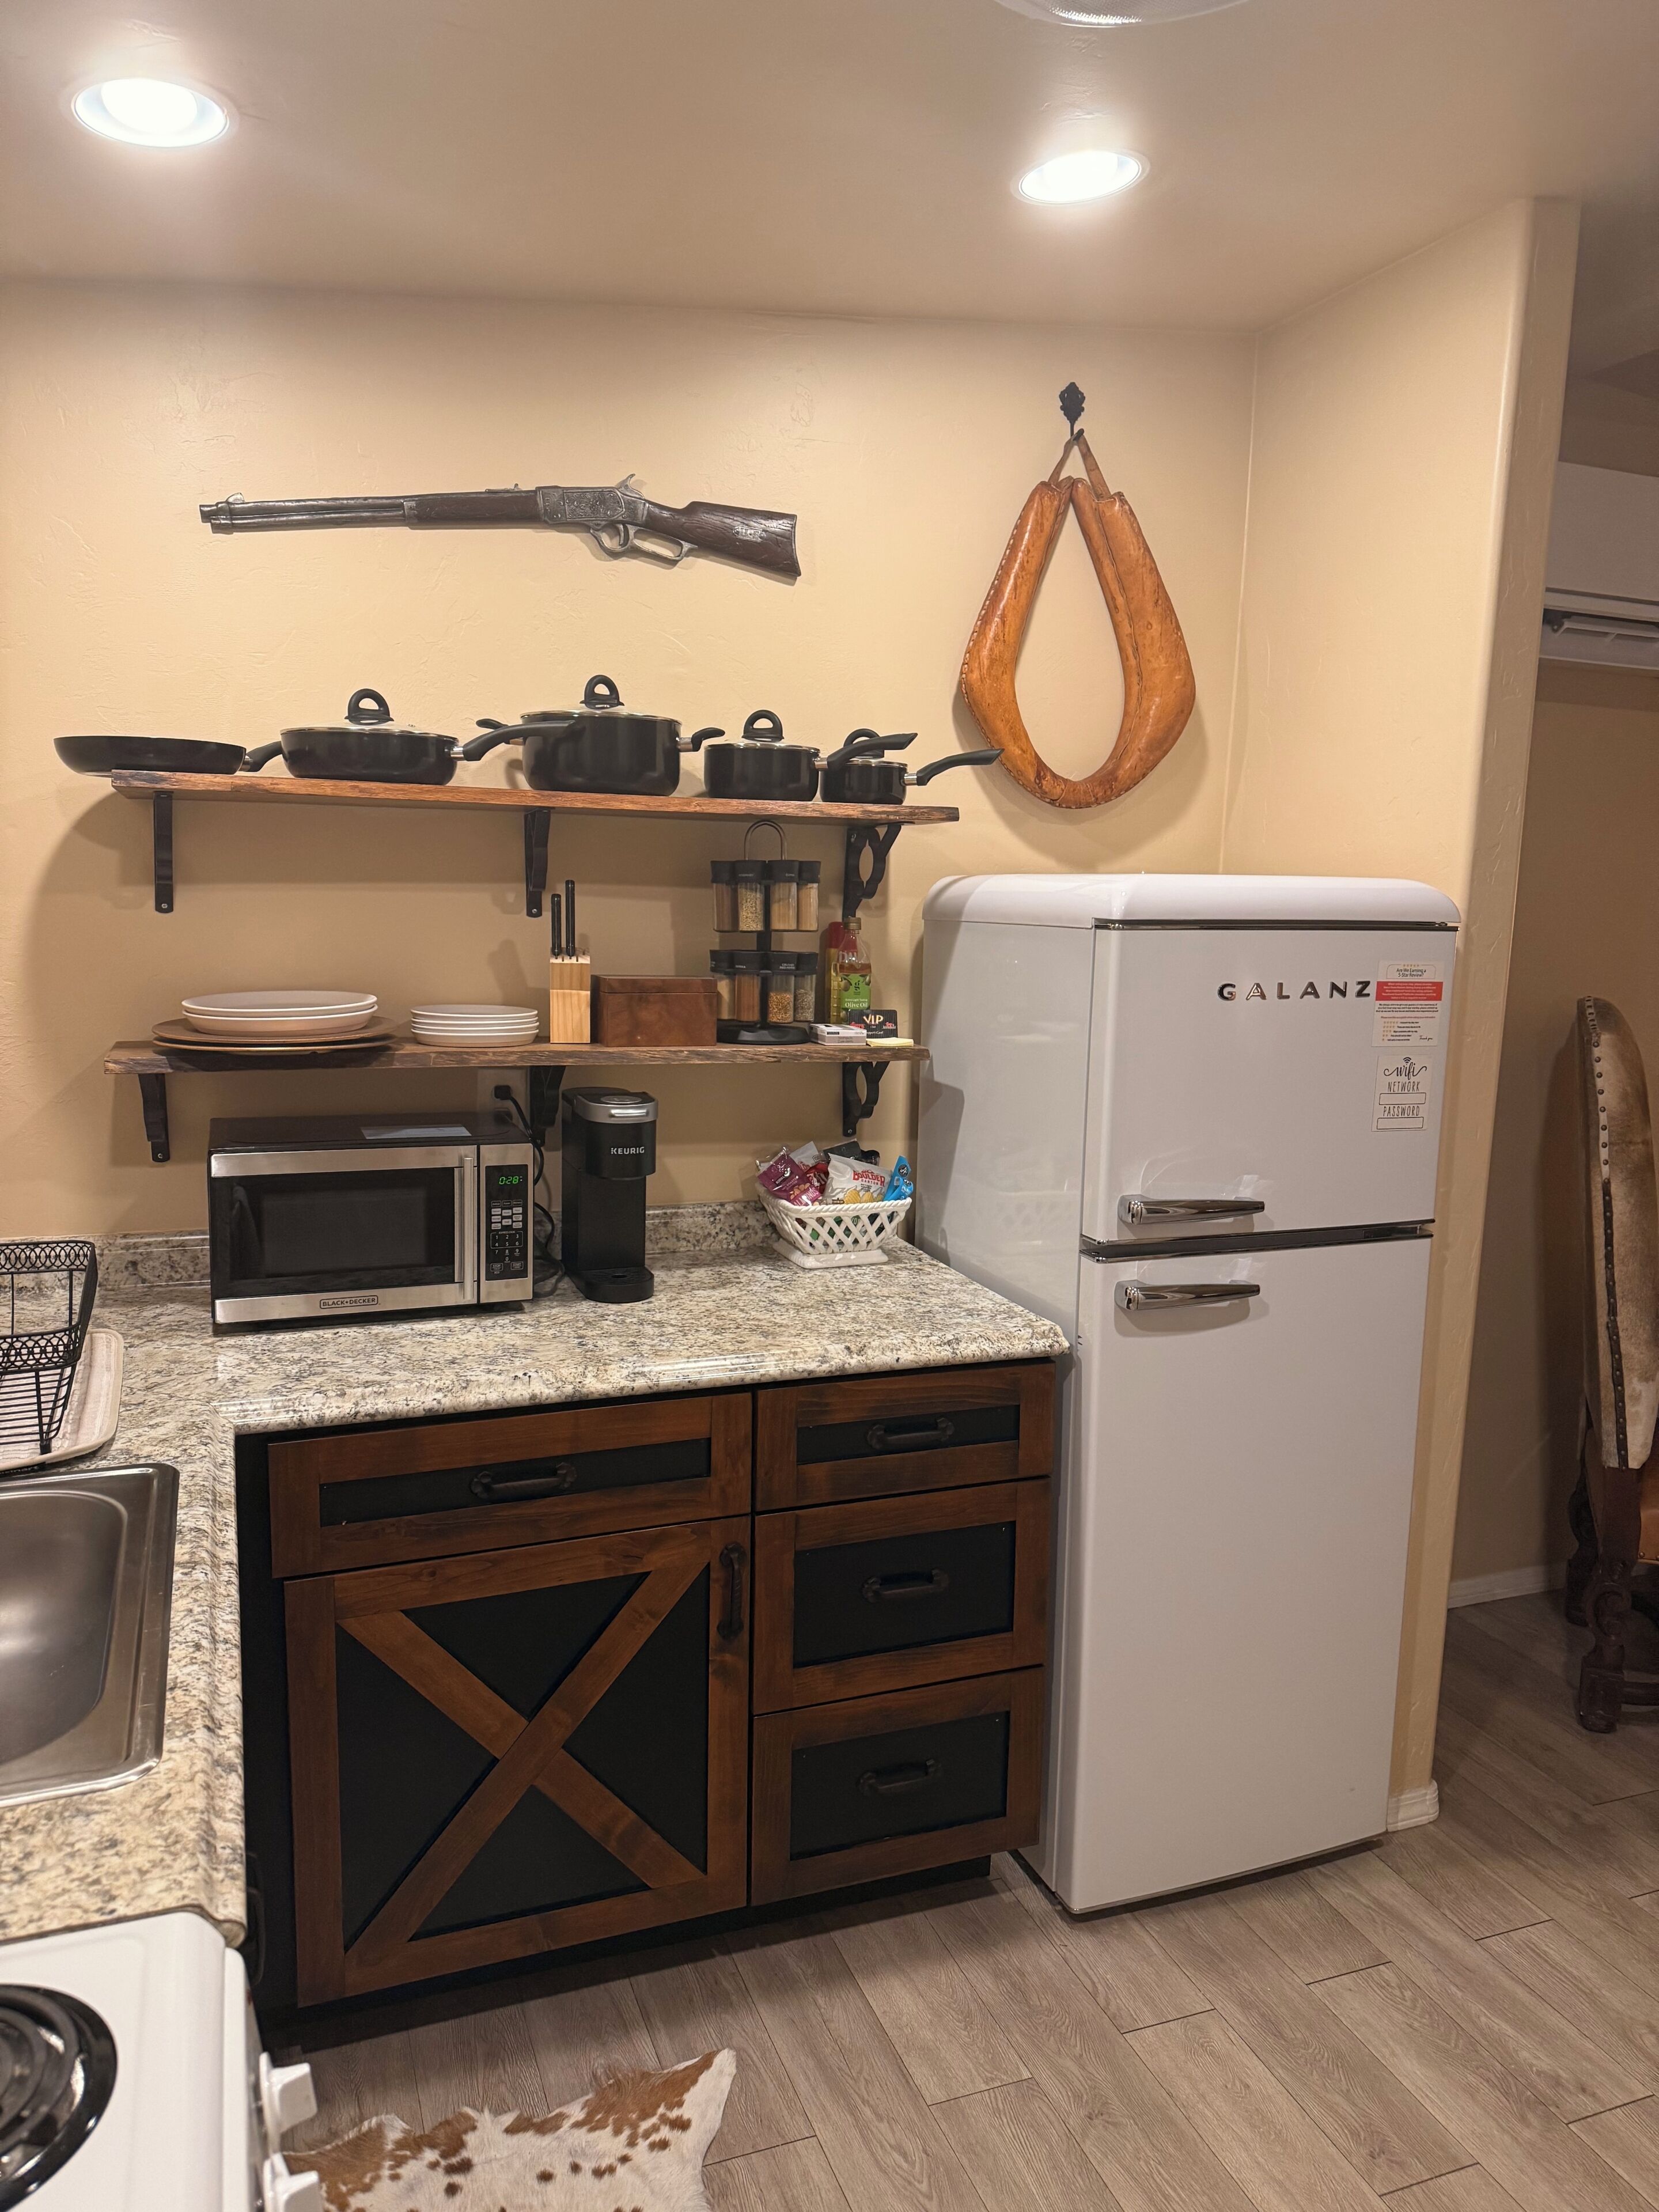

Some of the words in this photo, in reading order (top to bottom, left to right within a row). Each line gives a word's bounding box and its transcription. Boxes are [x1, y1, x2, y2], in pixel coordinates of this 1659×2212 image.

[1217, 980, 1370, 1001] GALANZ
[863, 1014, 884, 1024] VIP
[1384, 1062, 1427, 1080] wifi
[1388, 1081, 1420, 1092] NETWORK
[1383, 1105, 1420, 1116] PASSWORD
[611, 1146, 645, 1154] KEURIG
[853, 1169, 885, 1187] BOULDER
